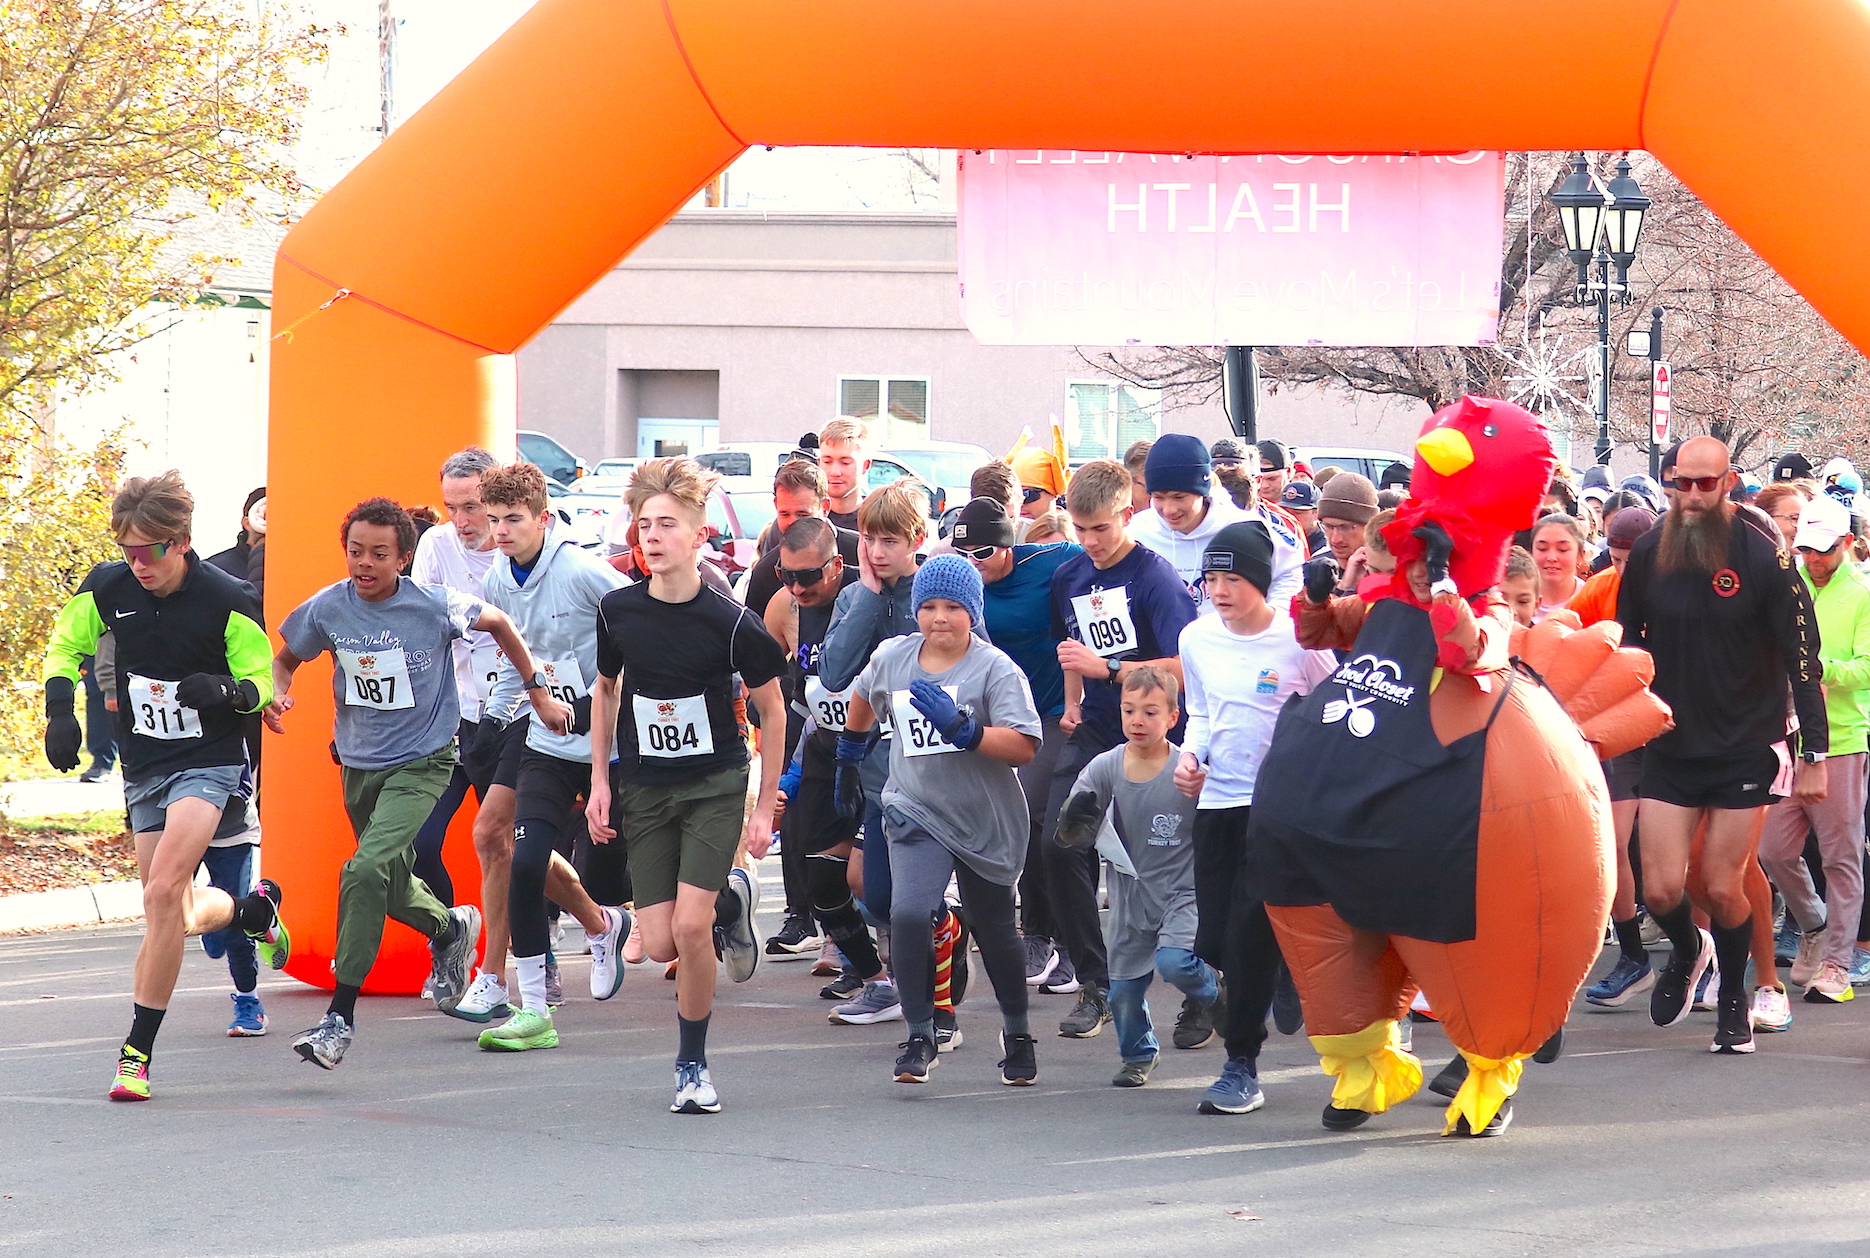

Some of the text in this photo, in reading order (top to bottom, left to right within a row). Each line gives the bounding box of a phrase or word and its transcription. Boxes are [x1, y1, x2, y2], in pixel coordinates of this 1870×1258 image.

[362, 629, 401, 651] Valley
[1089, 617, 1127, 650] 099
[354, 675, 396, 704] 087
[546, 683, 578, 703] 50
[1365, 671, 1415, 701] Closet
[1369, 688, 1409, 707] COMMUNITY
[141, 703, 186, 734] 311
[818, 700, 850, 726] 38
[648, 722, 699, 752] 084
[909, 718, 952, 748] 52
